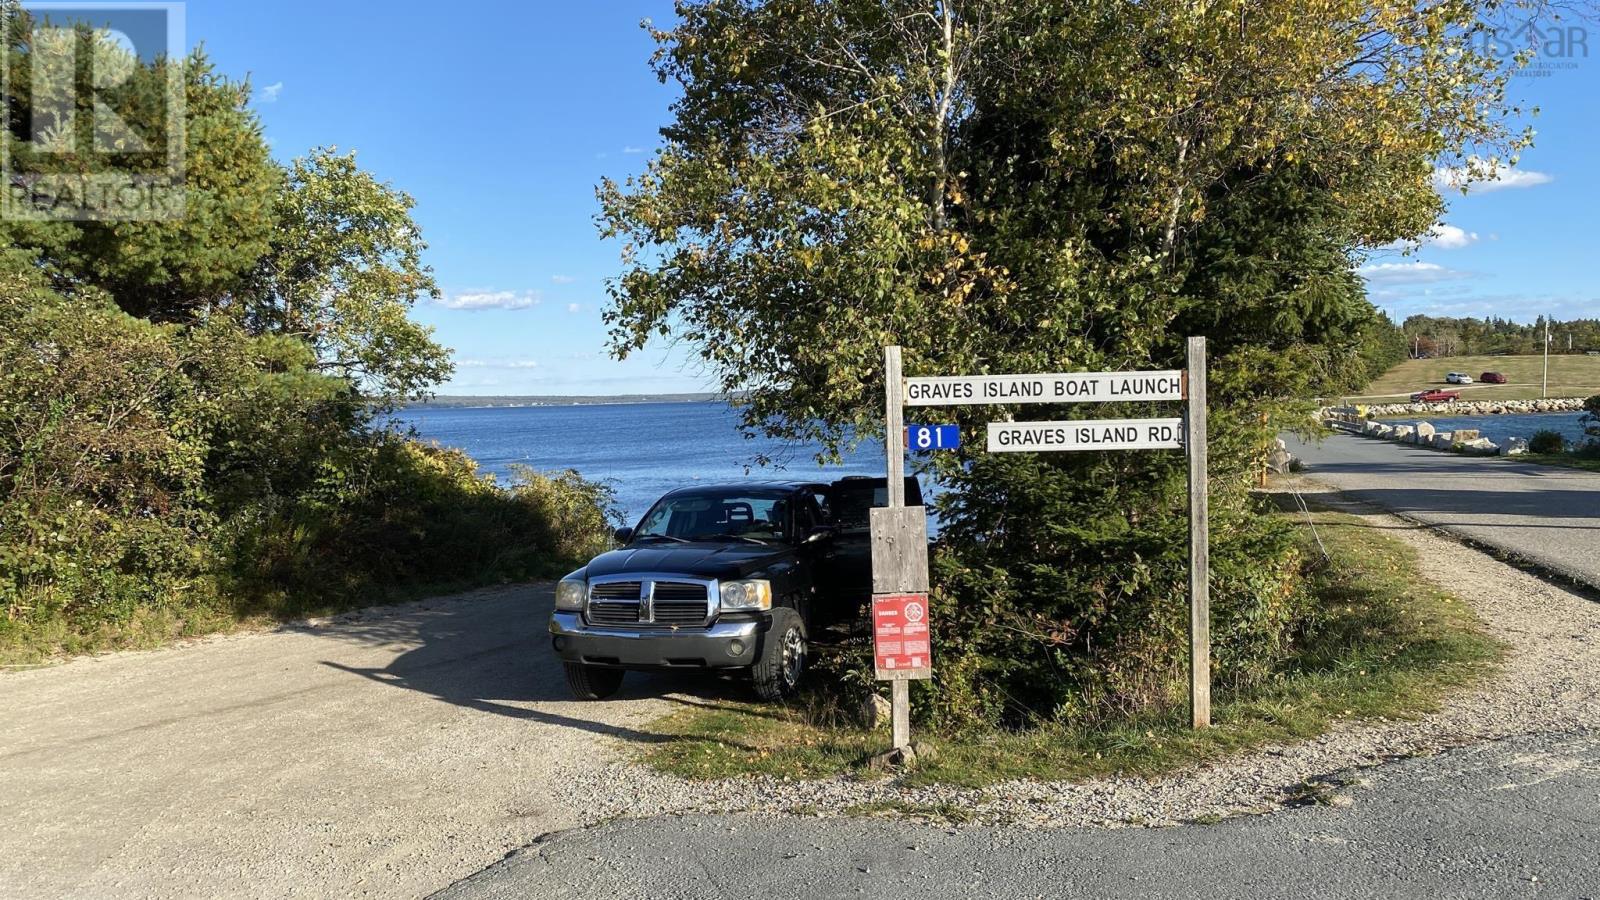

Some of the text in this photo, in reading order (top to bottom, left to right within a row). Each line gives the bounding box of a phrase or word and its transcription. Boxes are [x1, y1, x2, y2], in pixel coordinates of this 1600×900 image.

[908, 377, 1180, 399] GRAVES ISLAND BOAT LAUNCH
[917, 427, 942, 448] 81
[998, 426, 1177, 446] GRAVES ISLAND RD.
